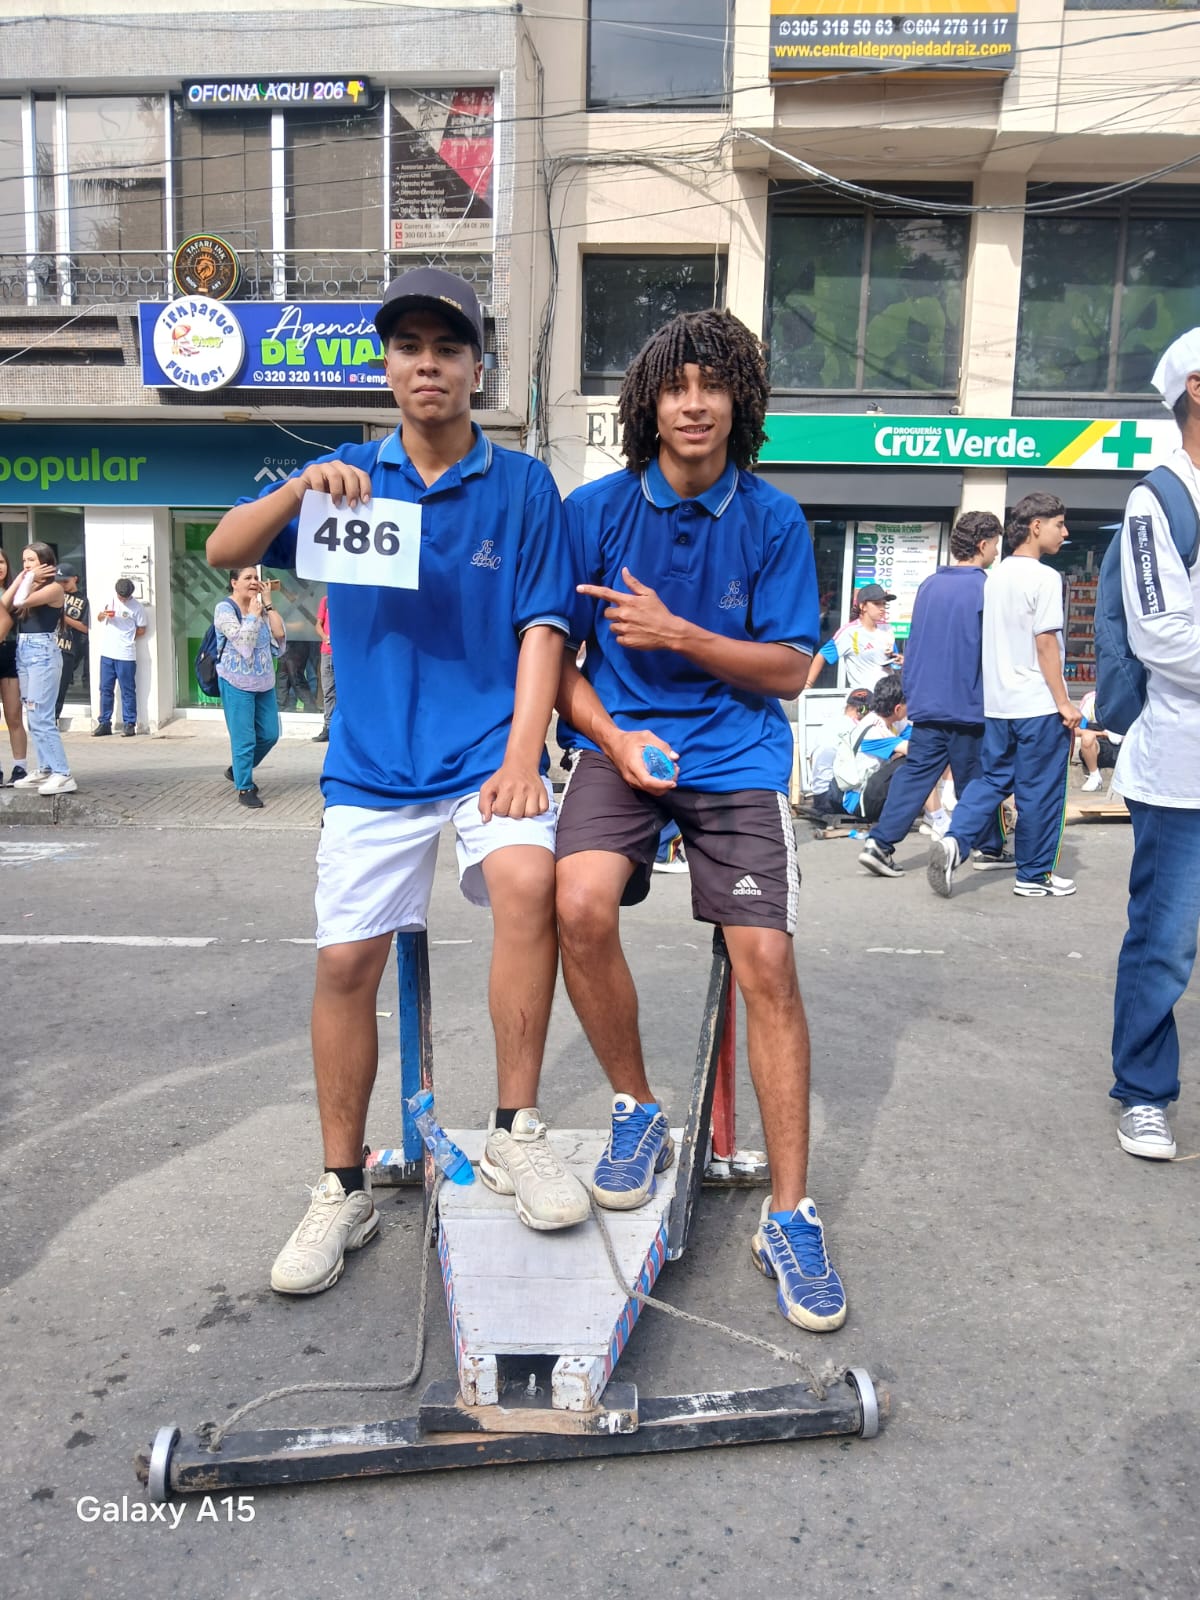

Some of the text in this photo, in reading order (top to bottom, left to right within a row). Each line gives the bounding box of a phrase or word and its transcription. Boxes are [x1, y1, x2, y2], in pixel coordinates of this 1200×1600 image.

[791, 18, 1009, 36] 305 318 50 63 604 278 11 17
[774, 40, 1012, 60] www.centraldepropiedadraiz.com
[188, 82, 344, 102] OFICINA AQUI 206
[261, 338, 306, 366] DE
[264, 370, 286, 383] 320
[288, 370, 310, 383] 320
[313, 370, 342, 383] 1106
[893, 426, 942, 435] DROGUERÍAS
[874, 426, 942, 457] Cruz
[263, 456, 297, 467] Grupo
[313, 516, 400, 556] 486
[732, 887, 762, 896] adidas
